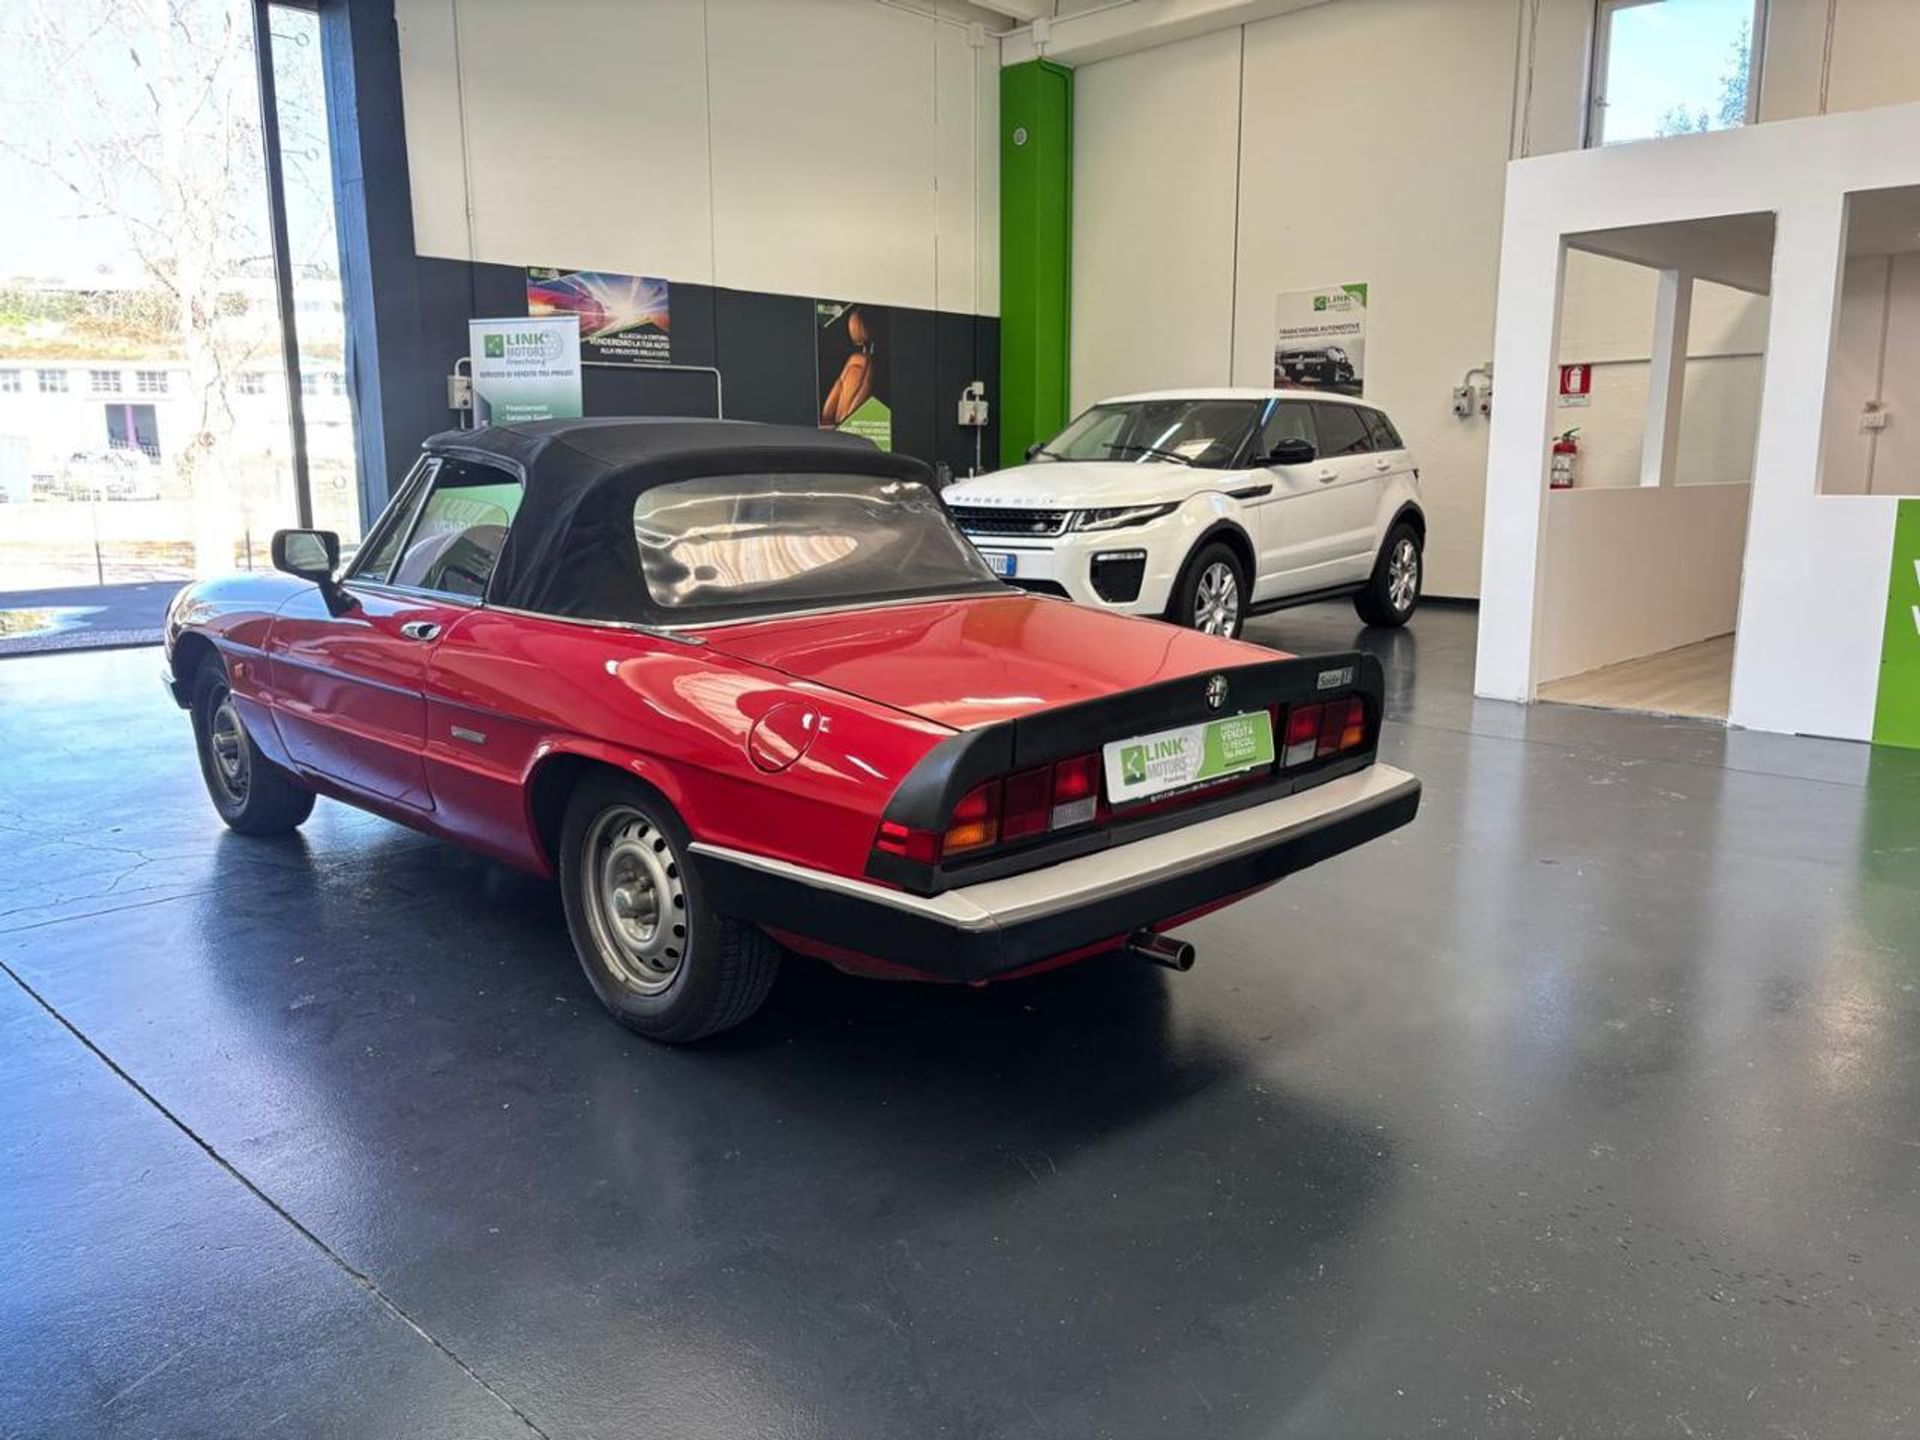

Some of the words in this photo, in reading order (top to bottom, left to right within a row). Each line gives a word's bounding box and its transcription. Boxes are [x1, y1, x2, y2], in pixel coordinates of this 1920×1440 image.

[506, 333, 545, 345] LINK
[506, 346, 546, 358] MOTORS
[1145, 737, 1185, 760] LINK
[1147, 756, 1187, 778] MOTORS
